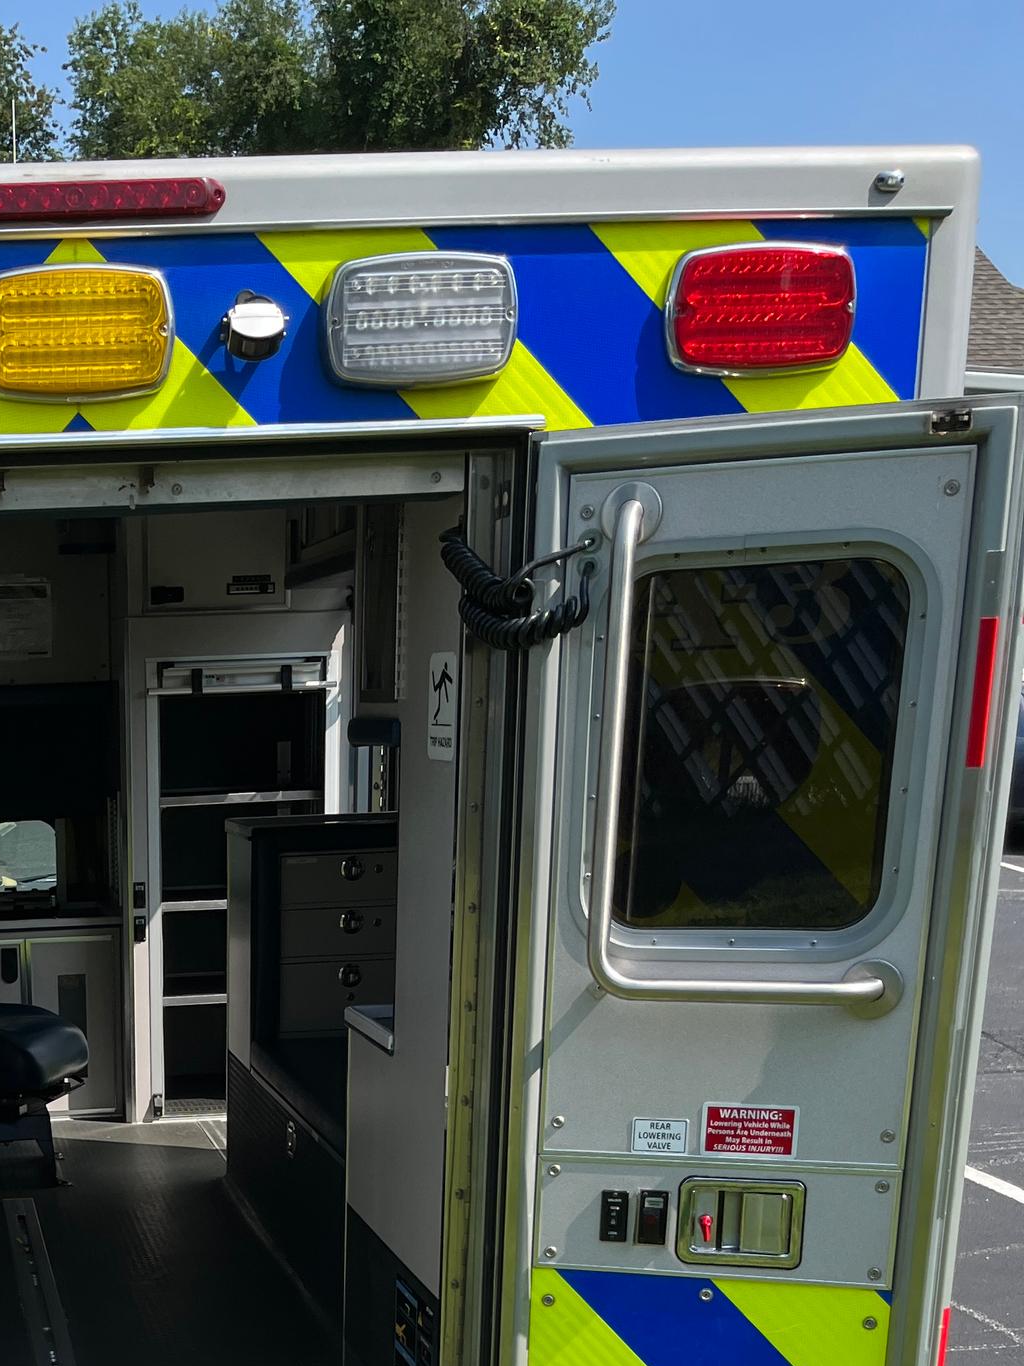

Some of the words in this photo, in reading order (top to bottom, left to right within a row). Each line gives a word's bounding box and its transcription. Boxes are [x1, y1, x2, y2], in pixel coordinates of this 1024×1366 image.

[719, 1108, 783, 1120] WARNING:
[649, 1122, 671, 1130] REAR
[710, 1120, 743, 1128] Lowering
[743, 1121, 769, 1129] Vehicle
[770, 1122, 791, 1130] While
[638, 1131, 681, 1141] LOWERING
[707, 1127, 735, 1135] Persons
[736, 1128, 749, 1136] Are
[749, 1129, 792, 1137] Underneath
[725, 1136, 740, 1144] May
[647, 1141, 672, 1150] VALVE
[713, 1143, 747, 1152] SERIOUS
[747, 1144, 784, 1153] INJURY!!!
